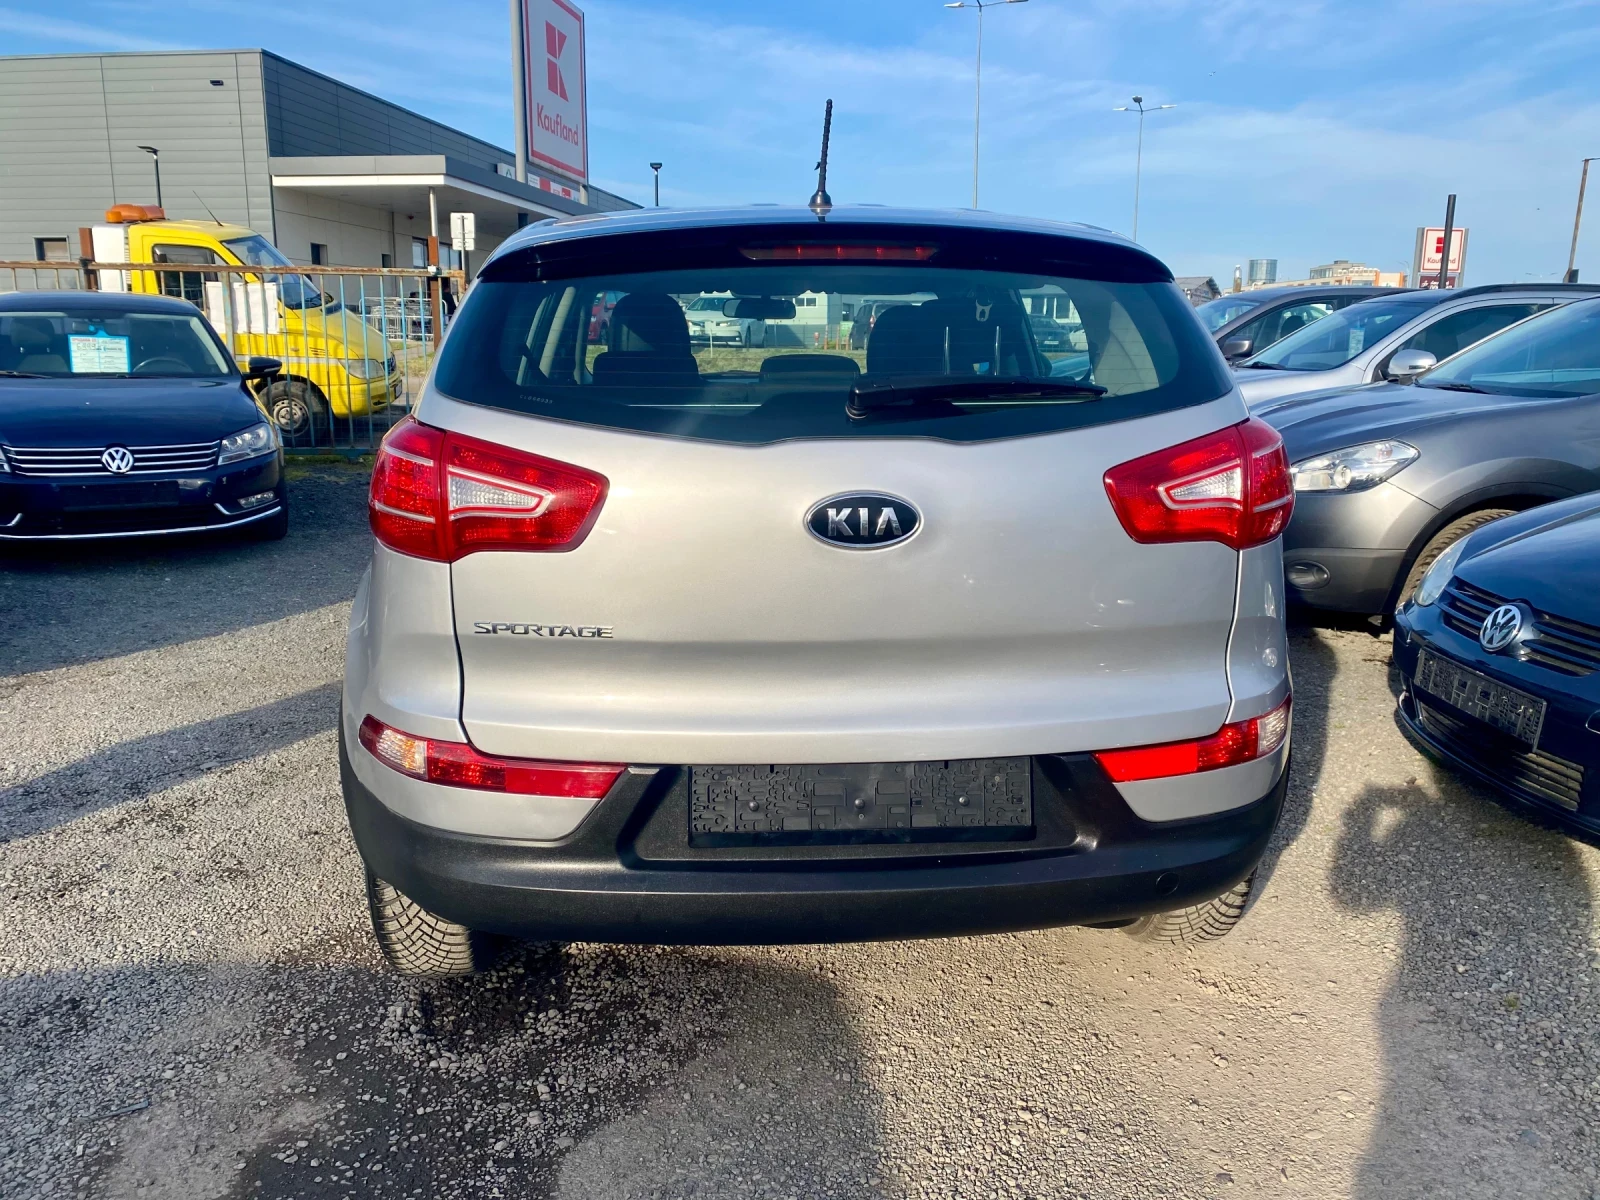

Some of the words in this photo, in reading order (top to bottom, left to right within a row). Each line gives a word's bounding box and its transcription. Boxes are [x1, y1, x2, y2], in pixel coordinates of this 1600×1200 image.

[536, 102, 579, 146] Kaufland
[826, 507, 902, 537] KIA
[474, 621, 614, 639] SPORTAGE
